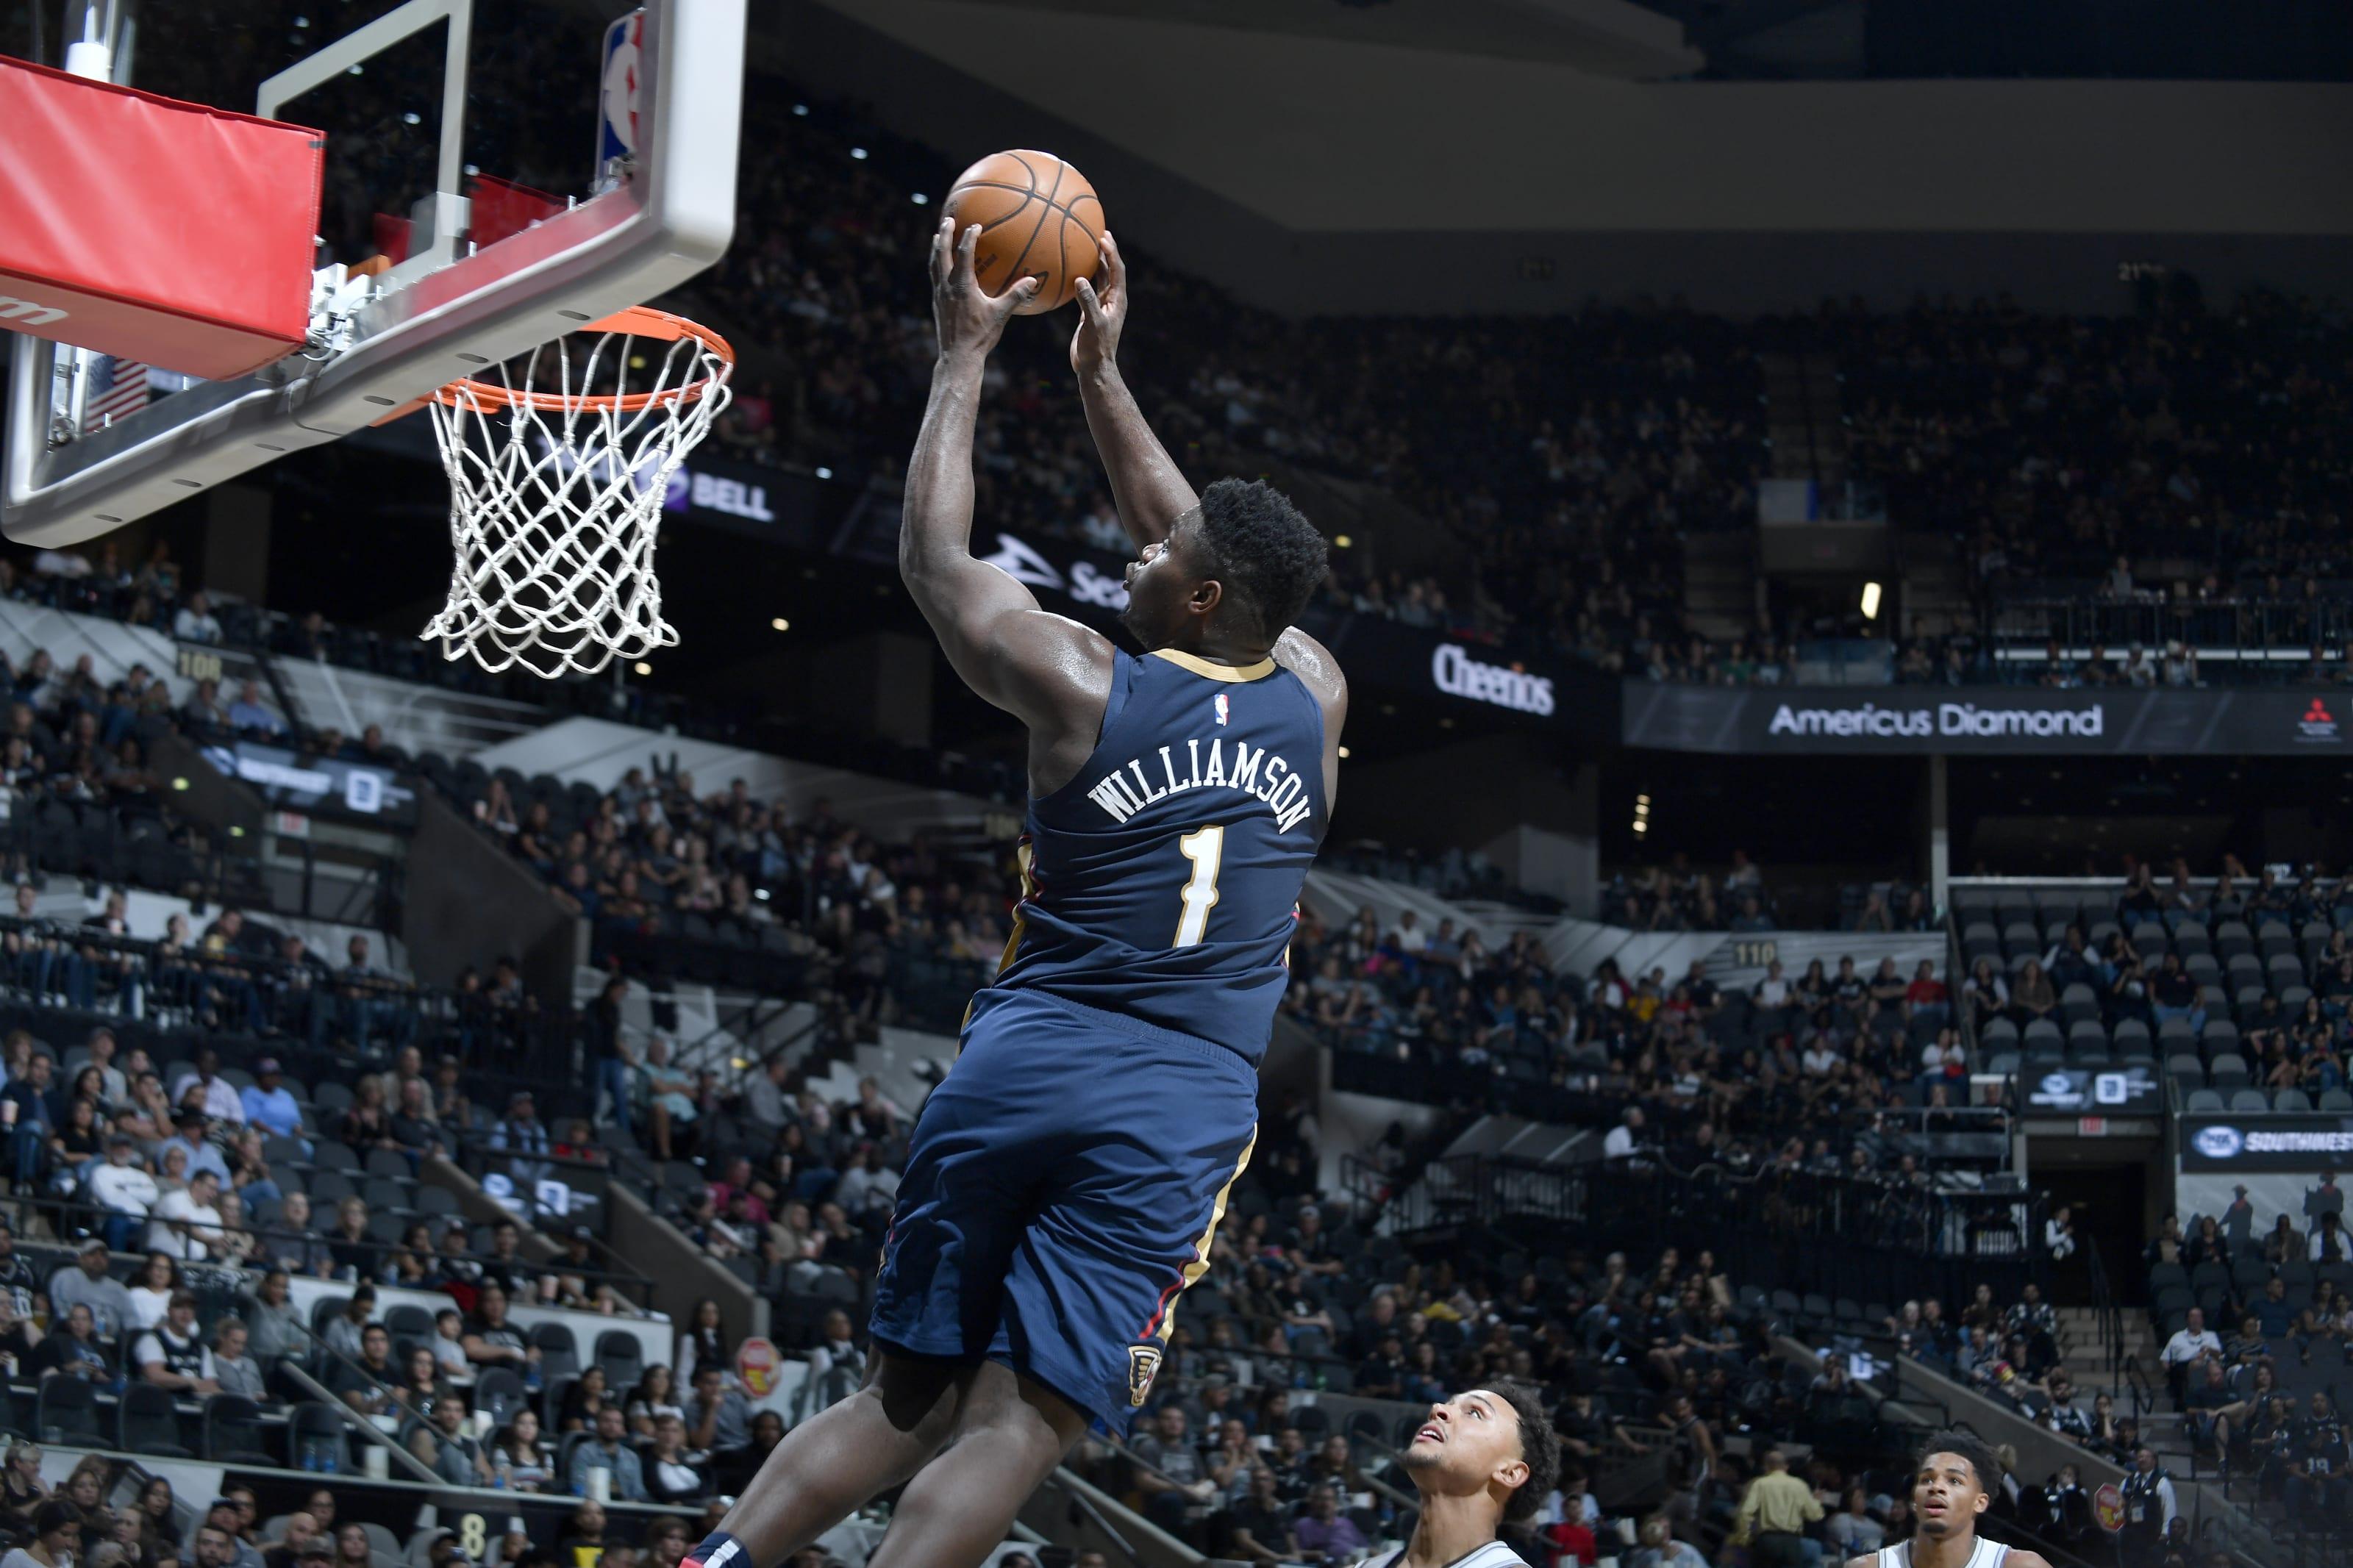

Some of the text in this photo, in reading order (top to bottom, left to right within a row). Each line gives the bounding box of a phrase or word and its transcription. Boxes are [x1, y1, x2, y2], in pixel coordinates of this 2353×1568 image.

[691, 470, 775, 523] BELL
[1768, 702, 2103, 736] Americus Diamond
[1086, 737, 1311, 835] WILLIAMSON
[1171, 823, 1224, 948] 1
[460, 1512, 487, 1558] 8
